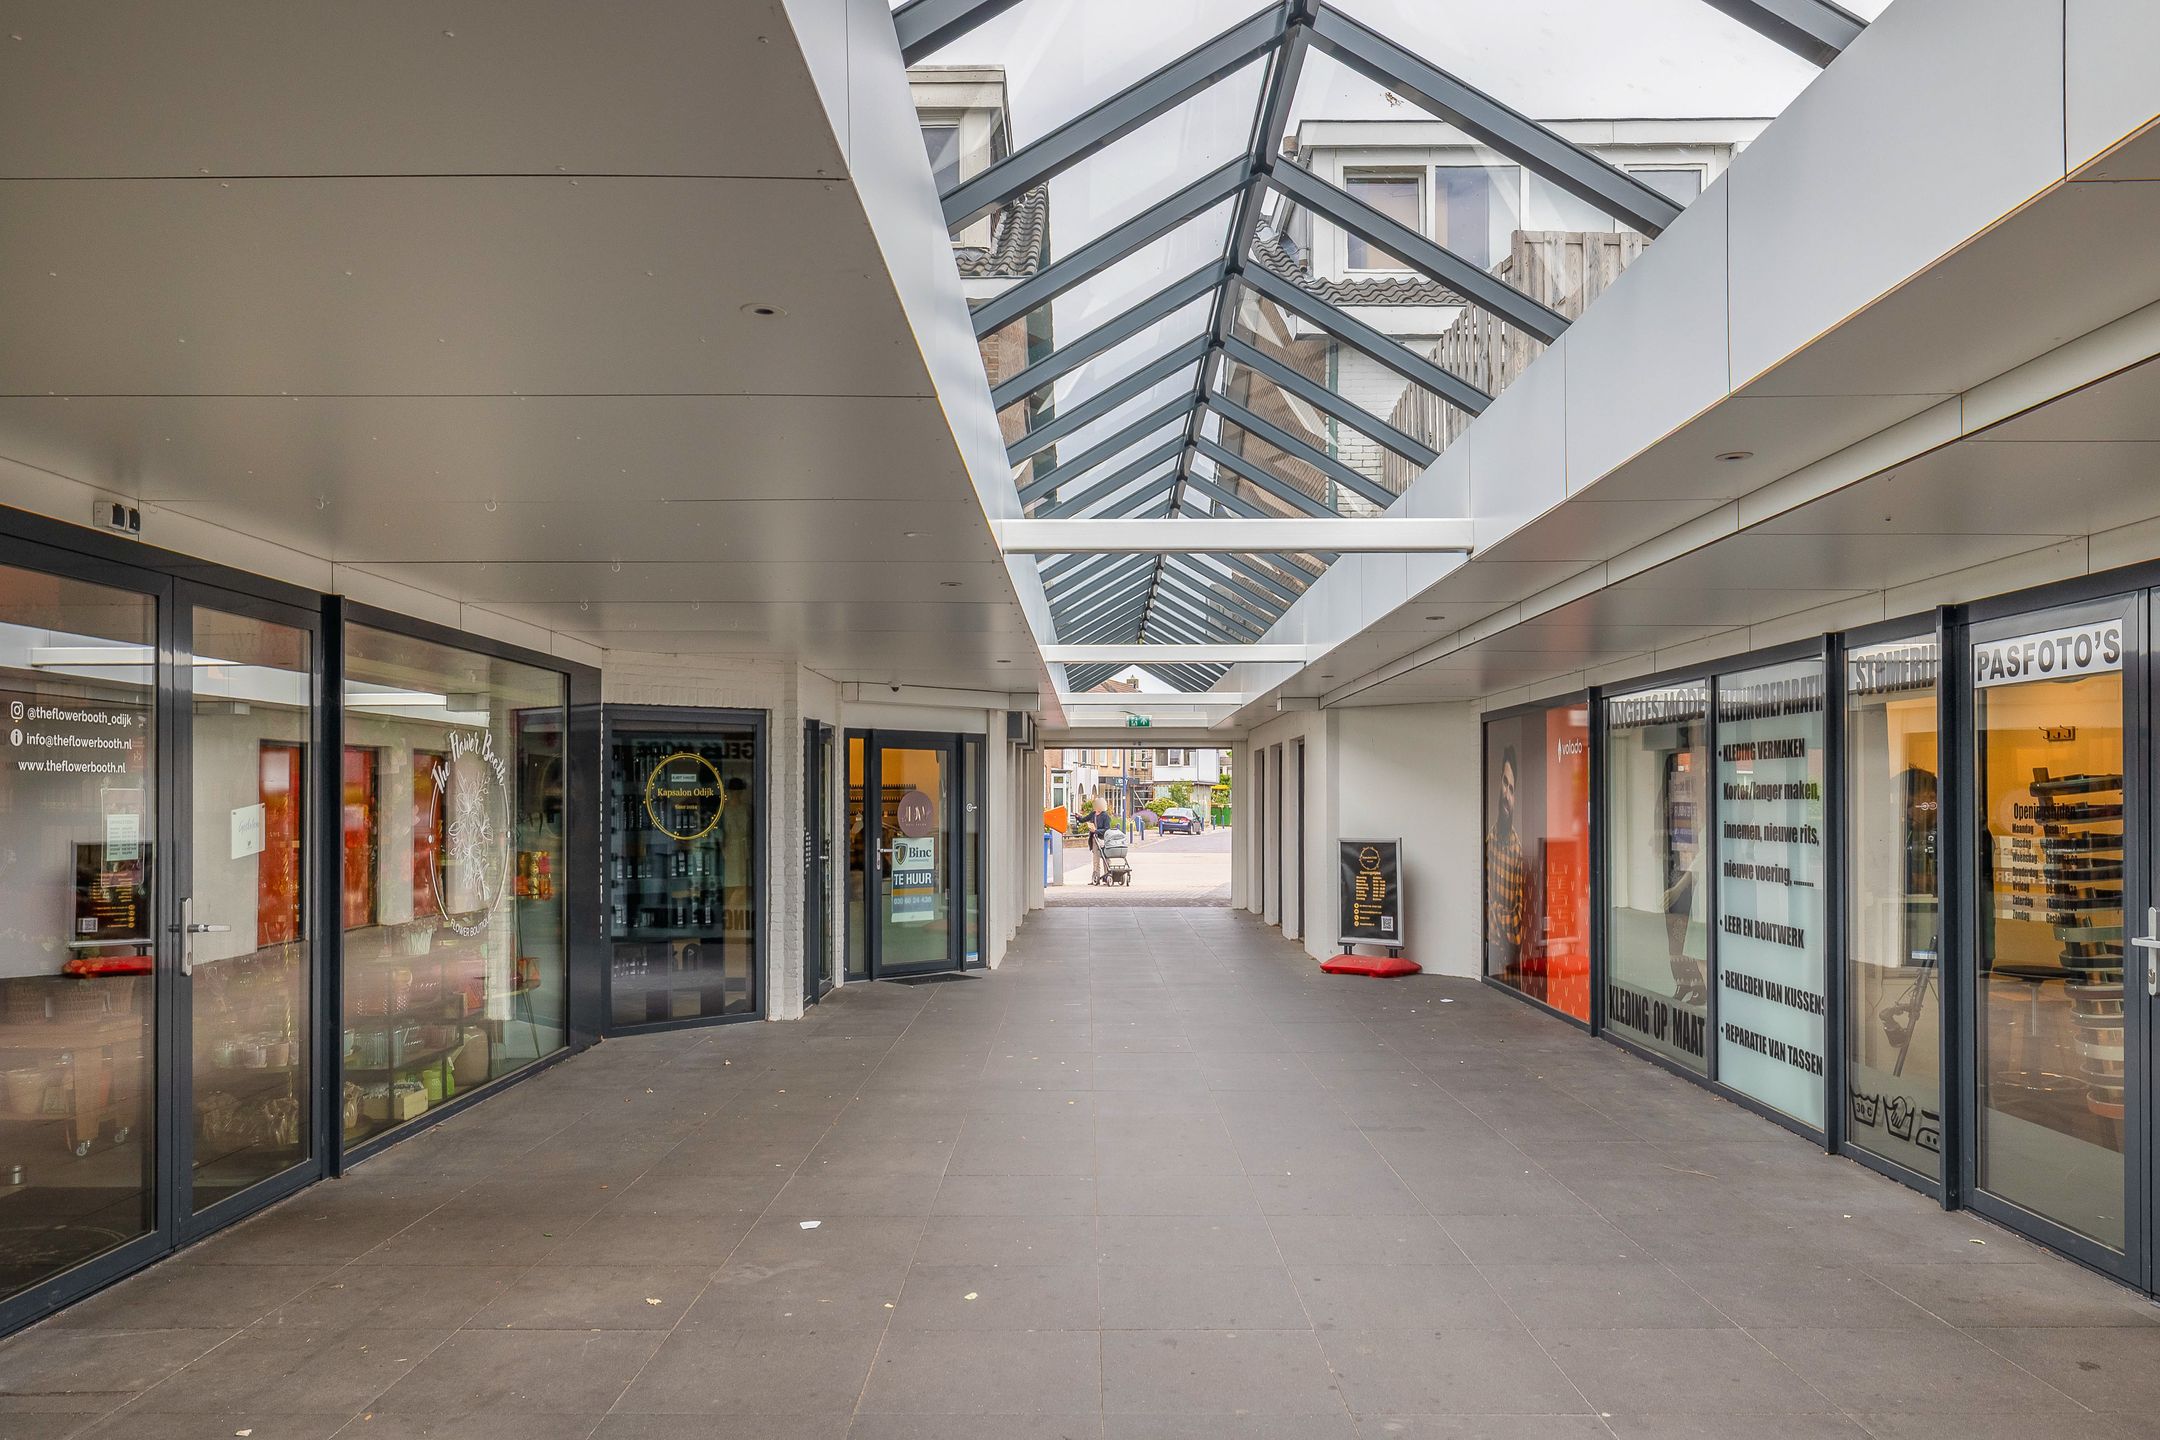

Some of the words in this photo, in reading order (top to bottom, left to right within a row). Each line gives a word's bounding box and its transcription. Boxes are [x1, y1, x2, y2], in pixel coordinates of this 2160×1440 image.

[1977, 628, 2121, 682] PASFOTO'S
[1856, 644, 1936, 696] STOMERIJ
[1718, 674, 1823, 723] KLEDINGREPARATI
[27, 706, 132, 728] @theflowerbooth_odijk
[26, 732, 132, 750] info@theflowerbooth.nl
[1723, 742, 1756, 762] KLEDING
[1757, 738, 1805, 759] VERMAKEN
[18, 759, 126, 774] www.theflowerbooth.nl
[431, 760, 450, 794] The
[482, 729, 506, 785] Booth
[657, 787, 692, 798] Kapsalon
[693, 787, 714, 798] Odijk
[1784, 780, 1819, 801] maken,
[1723, 821, 1762, 842] innemen,
[1763, 823, 1798, 843] nieuwe
[1799, 824, 1819, 846] rits,
[2012, 823, 2034, 835] Maandag
[909, 847, 932, 858] Binc
[2012, 838, 2031, 849] Dinsdag
[2012, 853, 2037, 864] Woensdag
[894, 873, 904, 886] TE
[906, 872, 932, 885] HUUR
[1723, 860, 1754, 880] nieuwe
[1755, 864, 1792, 886] voering,
[2012, 867, 2039, 879] Donderdag
[2012, 882, 2029, 893] Vrijdag
[2012, 895, 2033, 907] Zaterdag
[2012, 909, 2029, 922] Zondag
[1724, 915, 1741, 935] LEER
[1743, 918, 1753, 938] EN
[1754, 921, 1805, 949] BONTWERK
[1725, 969, 1763, 998] BEKLEDEN
[1765, 980, 1782, 1003] VAN
[1609, 984, 1649, 1035] KLEDING
[1653, 1000, 1668, 1041] OP
[1672, 1007, 1705, 1058] MAAT
[1725, 1022, 1767, 1055] REPARATIE
[1768, 1037, 1786, 1062] VAN
[1787, 1045, 1823, 1076] TASSEN
